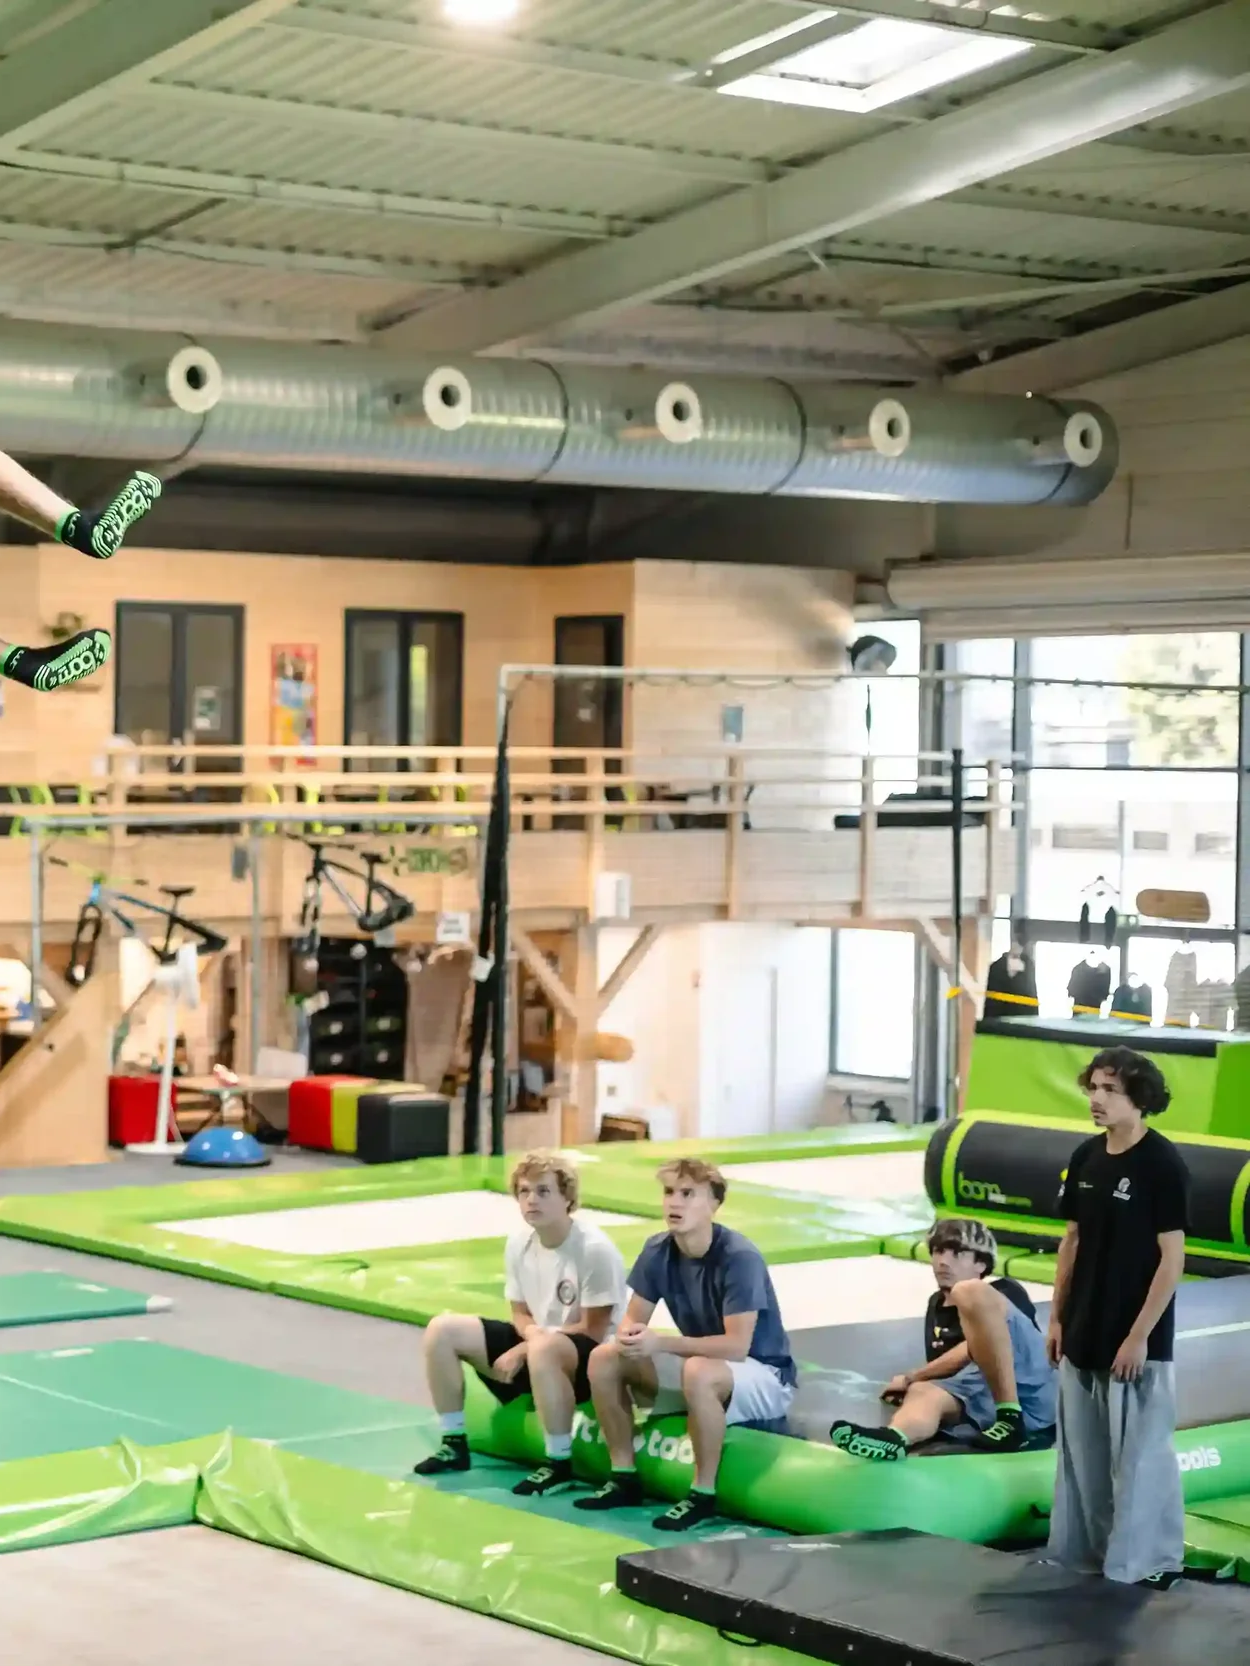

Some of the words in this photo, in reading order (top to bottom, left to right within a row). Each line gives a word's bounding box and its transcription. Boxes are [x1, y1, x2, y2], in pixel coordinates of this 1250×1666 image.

[57, 650, 97, 684] bom
[647, 1429, 696, 1464] too
[848, 1437, 887, 1459] bom
[1176, 1446, 1222, 1472] ools
